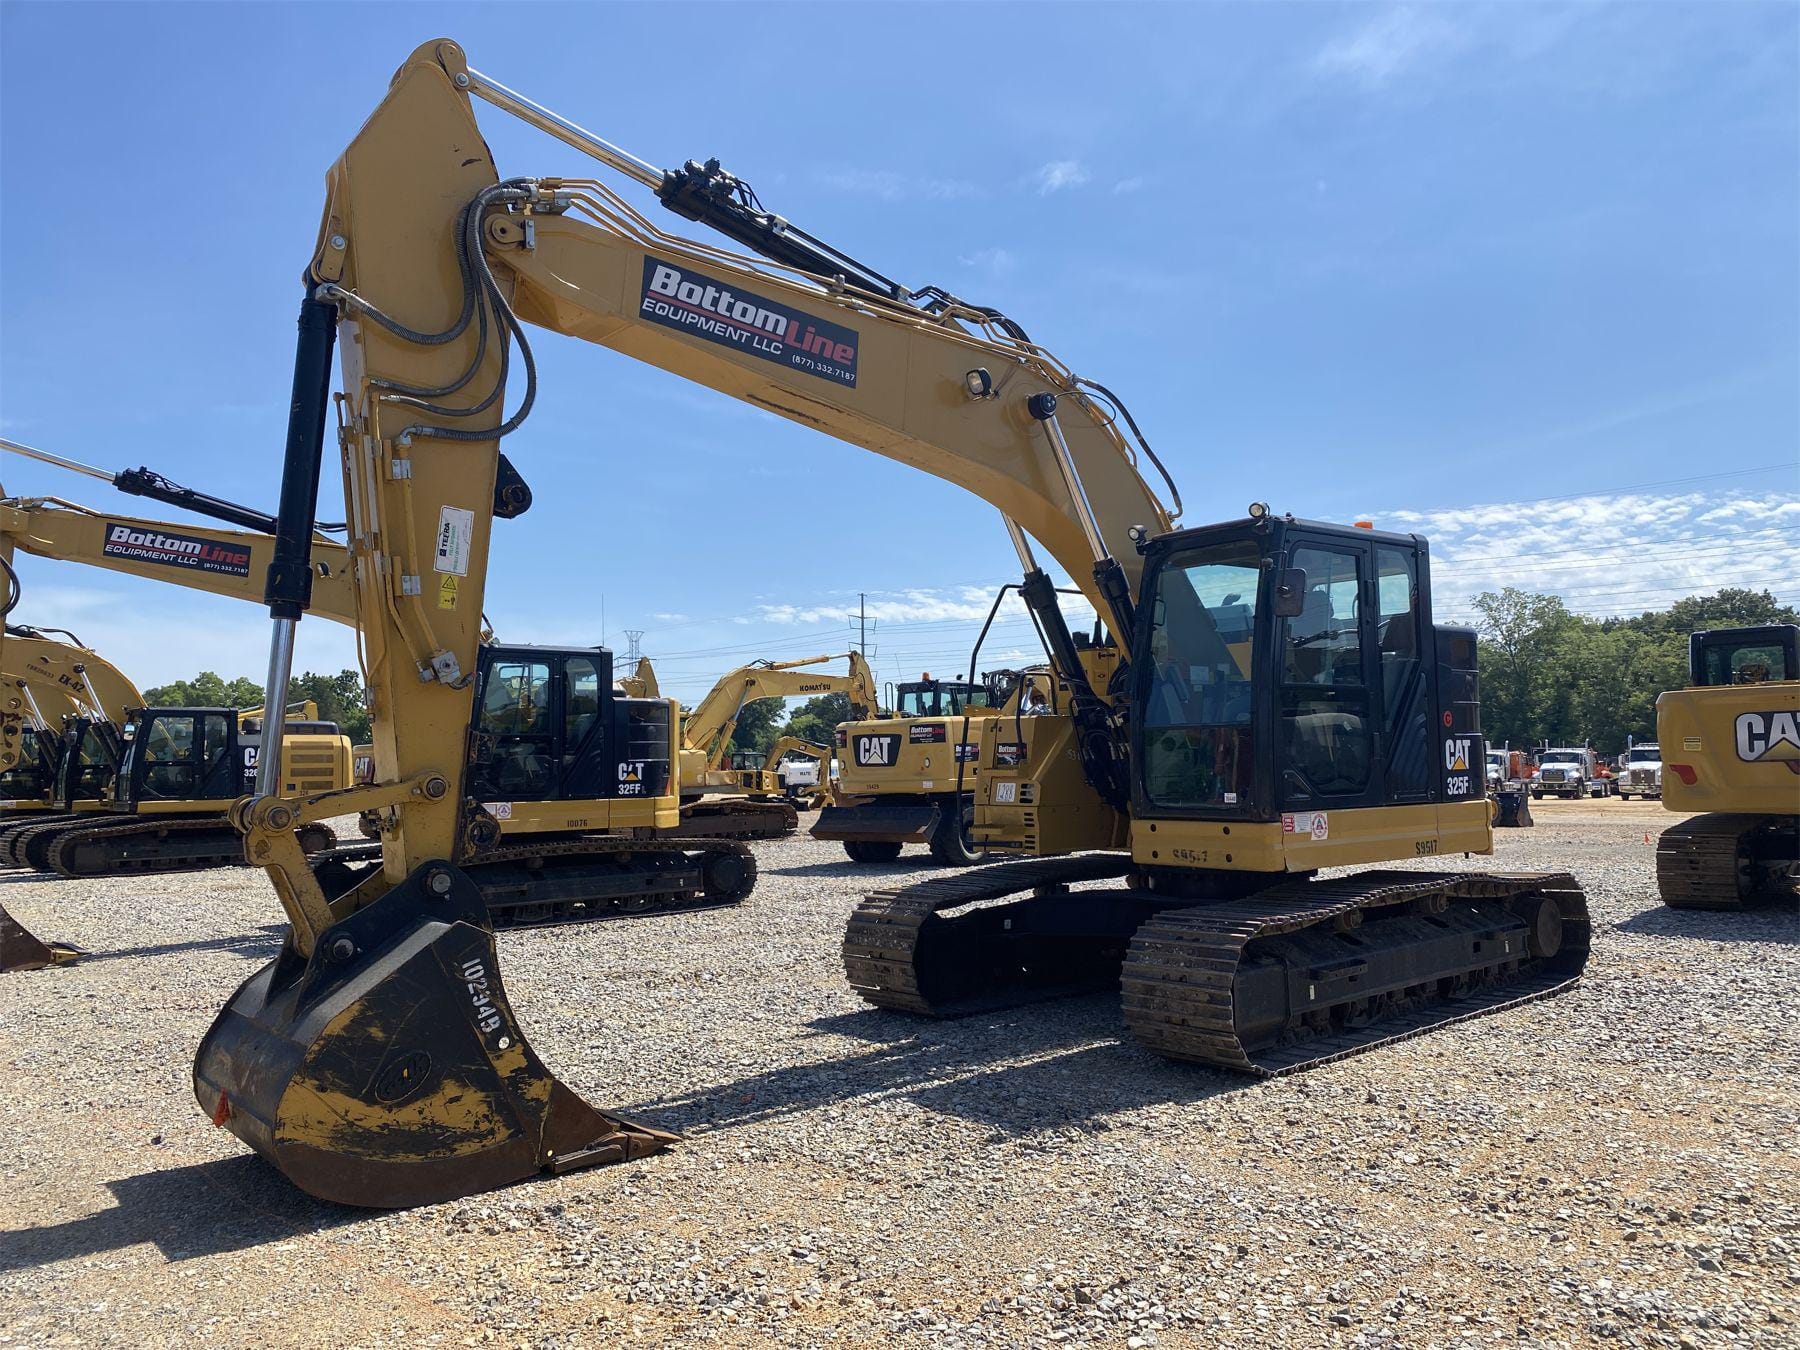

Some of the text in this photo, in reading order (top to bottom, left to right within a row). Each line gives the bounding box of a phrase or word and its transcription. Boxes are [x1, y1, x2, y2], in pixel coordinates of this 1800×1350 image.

[642, 297, 783, 355] EQUIPMENT LLC
[650, 264, 854, 365] BottomLine
[792, 354, 856, 382] (877) 332.7187
[105, 544, 199, 565] EQUIPMENT LLC
[110, 526, 248, 565] BottomLine
[800, 683, 831, 692] KOMATSU
[1736, 713, 1800, 761] CA
[860, 737, 890, 764] CAT
[1445, 740, 1471, 770] CAT
[355, 757, 370, 777] CAT
[618, 763, 645, 781] CAT
[1447, 777, 1469, 795] 325F
[567, 819, 588, 828] 10076
[1415, 840, 1438, 854] S9517
